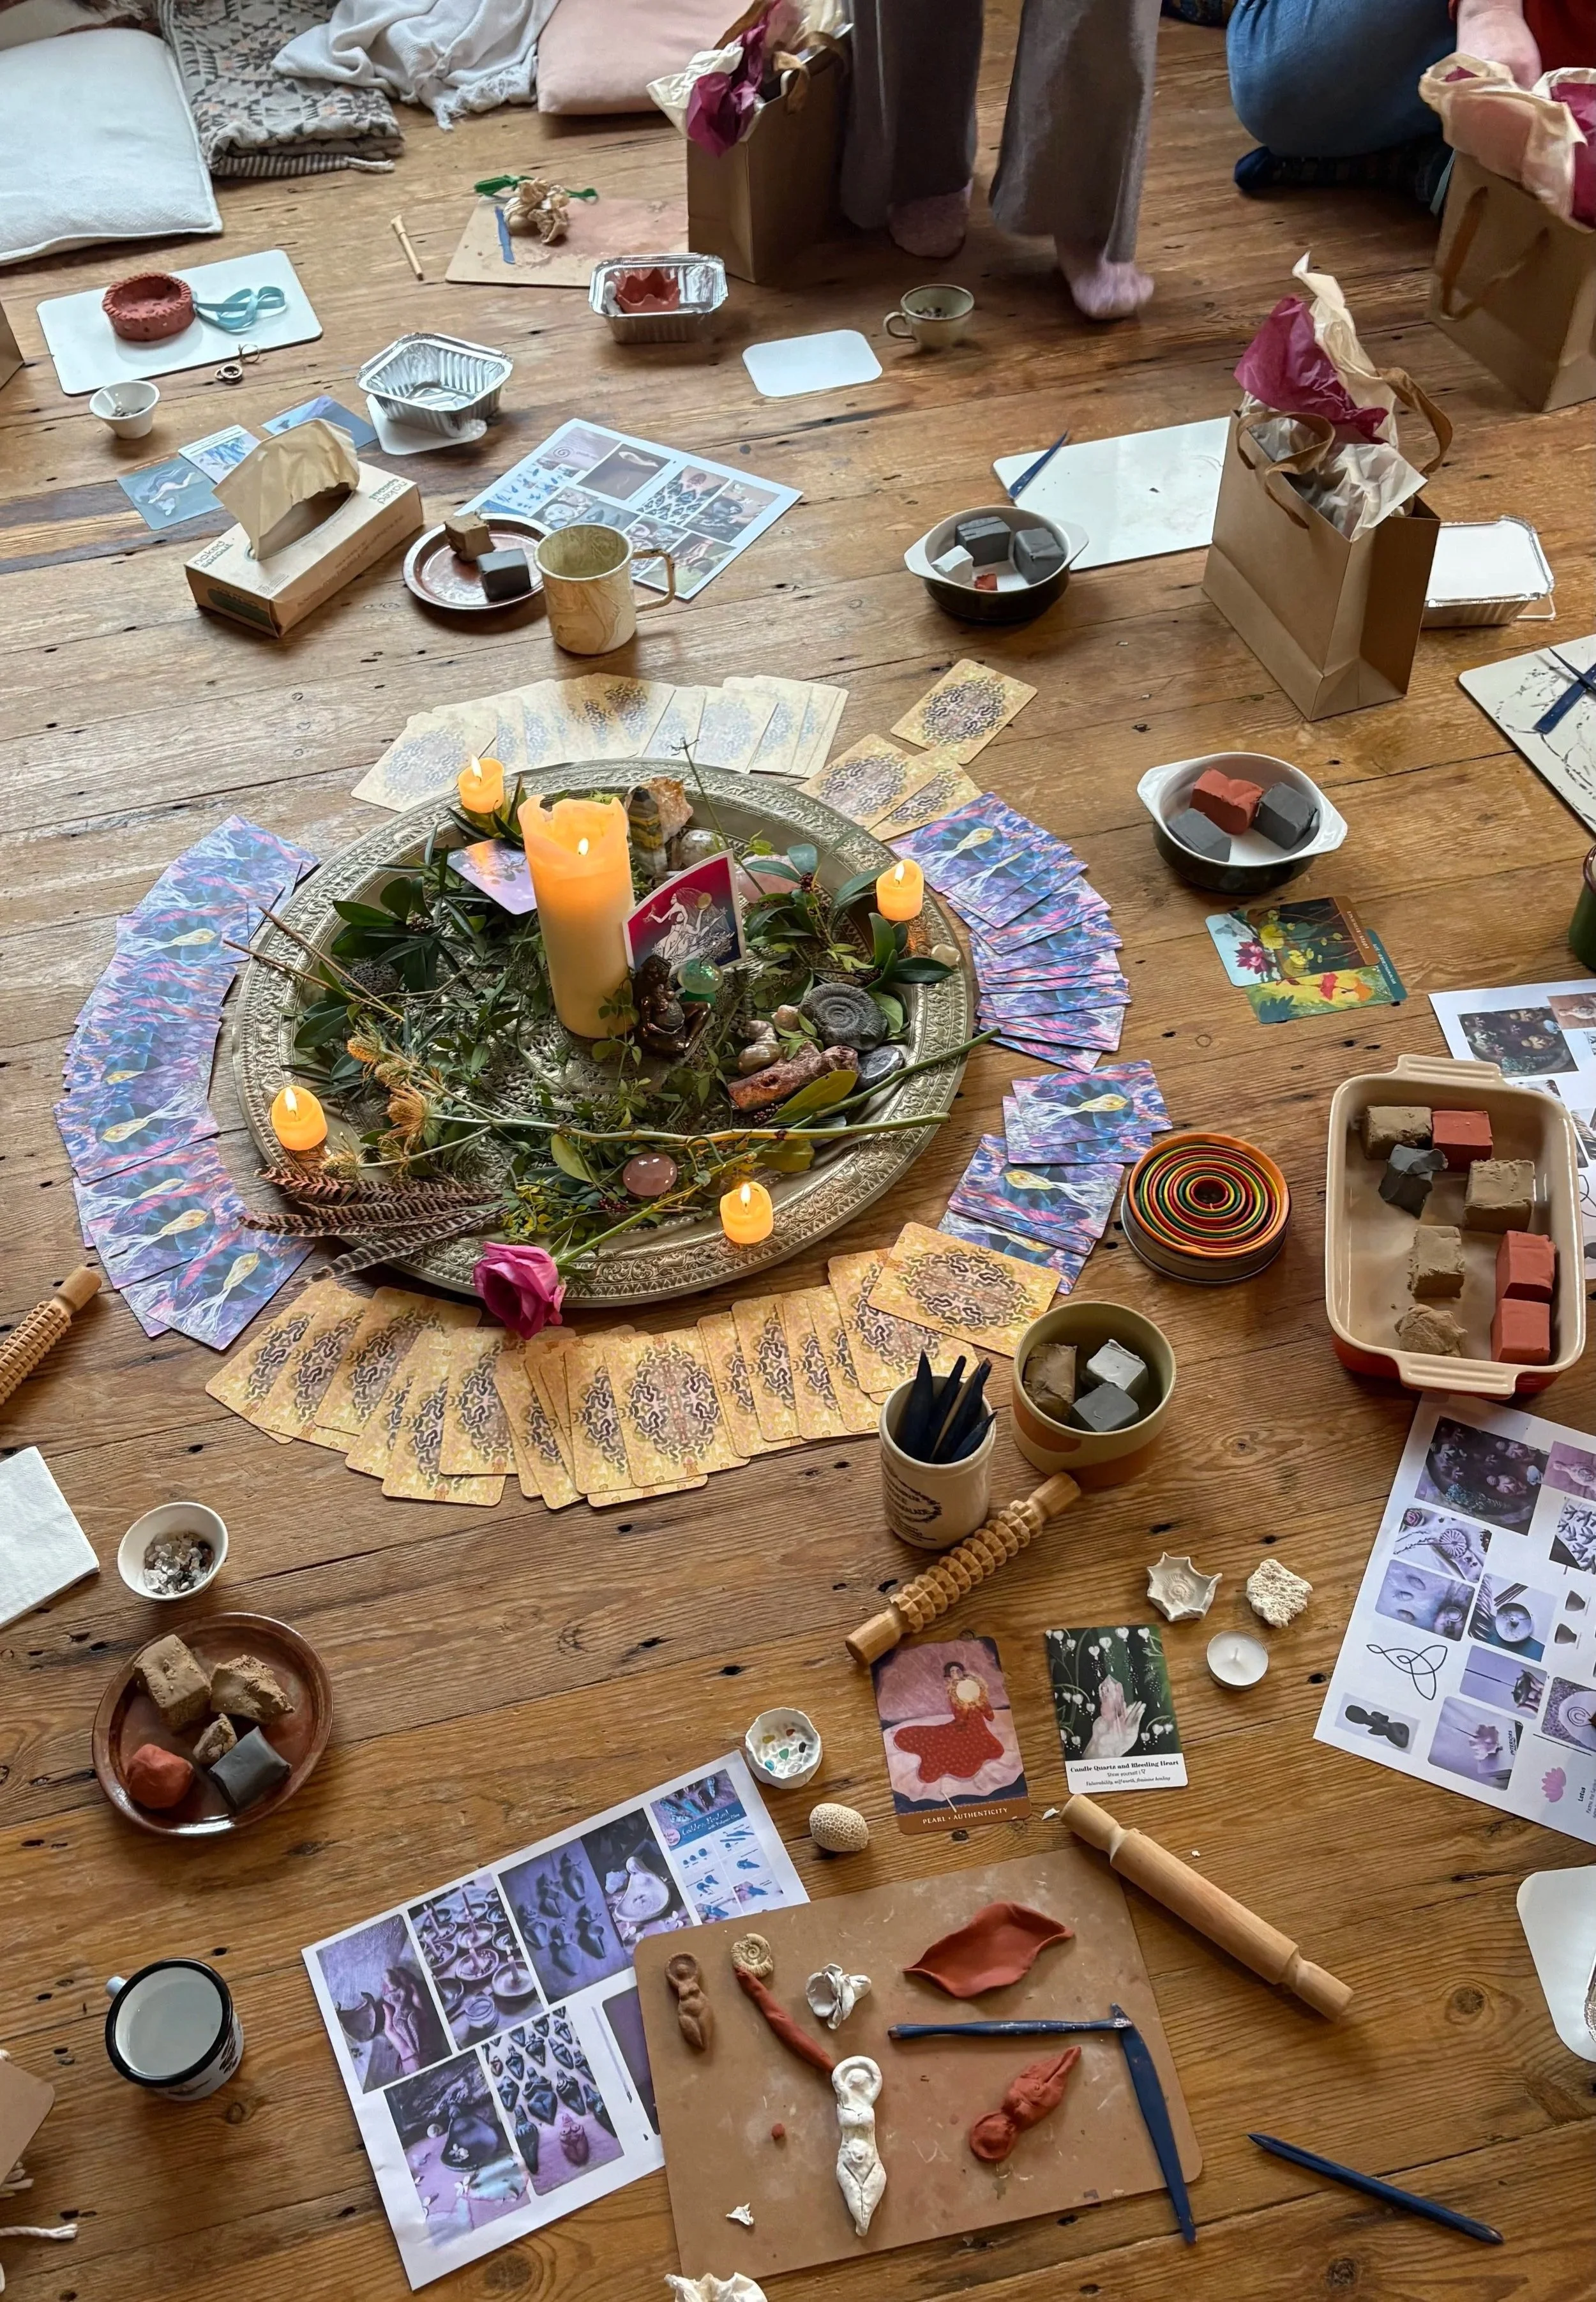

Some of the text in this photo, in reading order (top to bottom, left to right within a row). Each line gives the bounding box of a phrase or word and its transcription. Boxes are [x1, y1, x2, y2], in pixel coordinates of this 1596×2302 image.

[378, 481, 408, 505] naked
[193, 541, 225, 566] naked
[953, 1808, 1008, 1820] AUTHENTICITY
